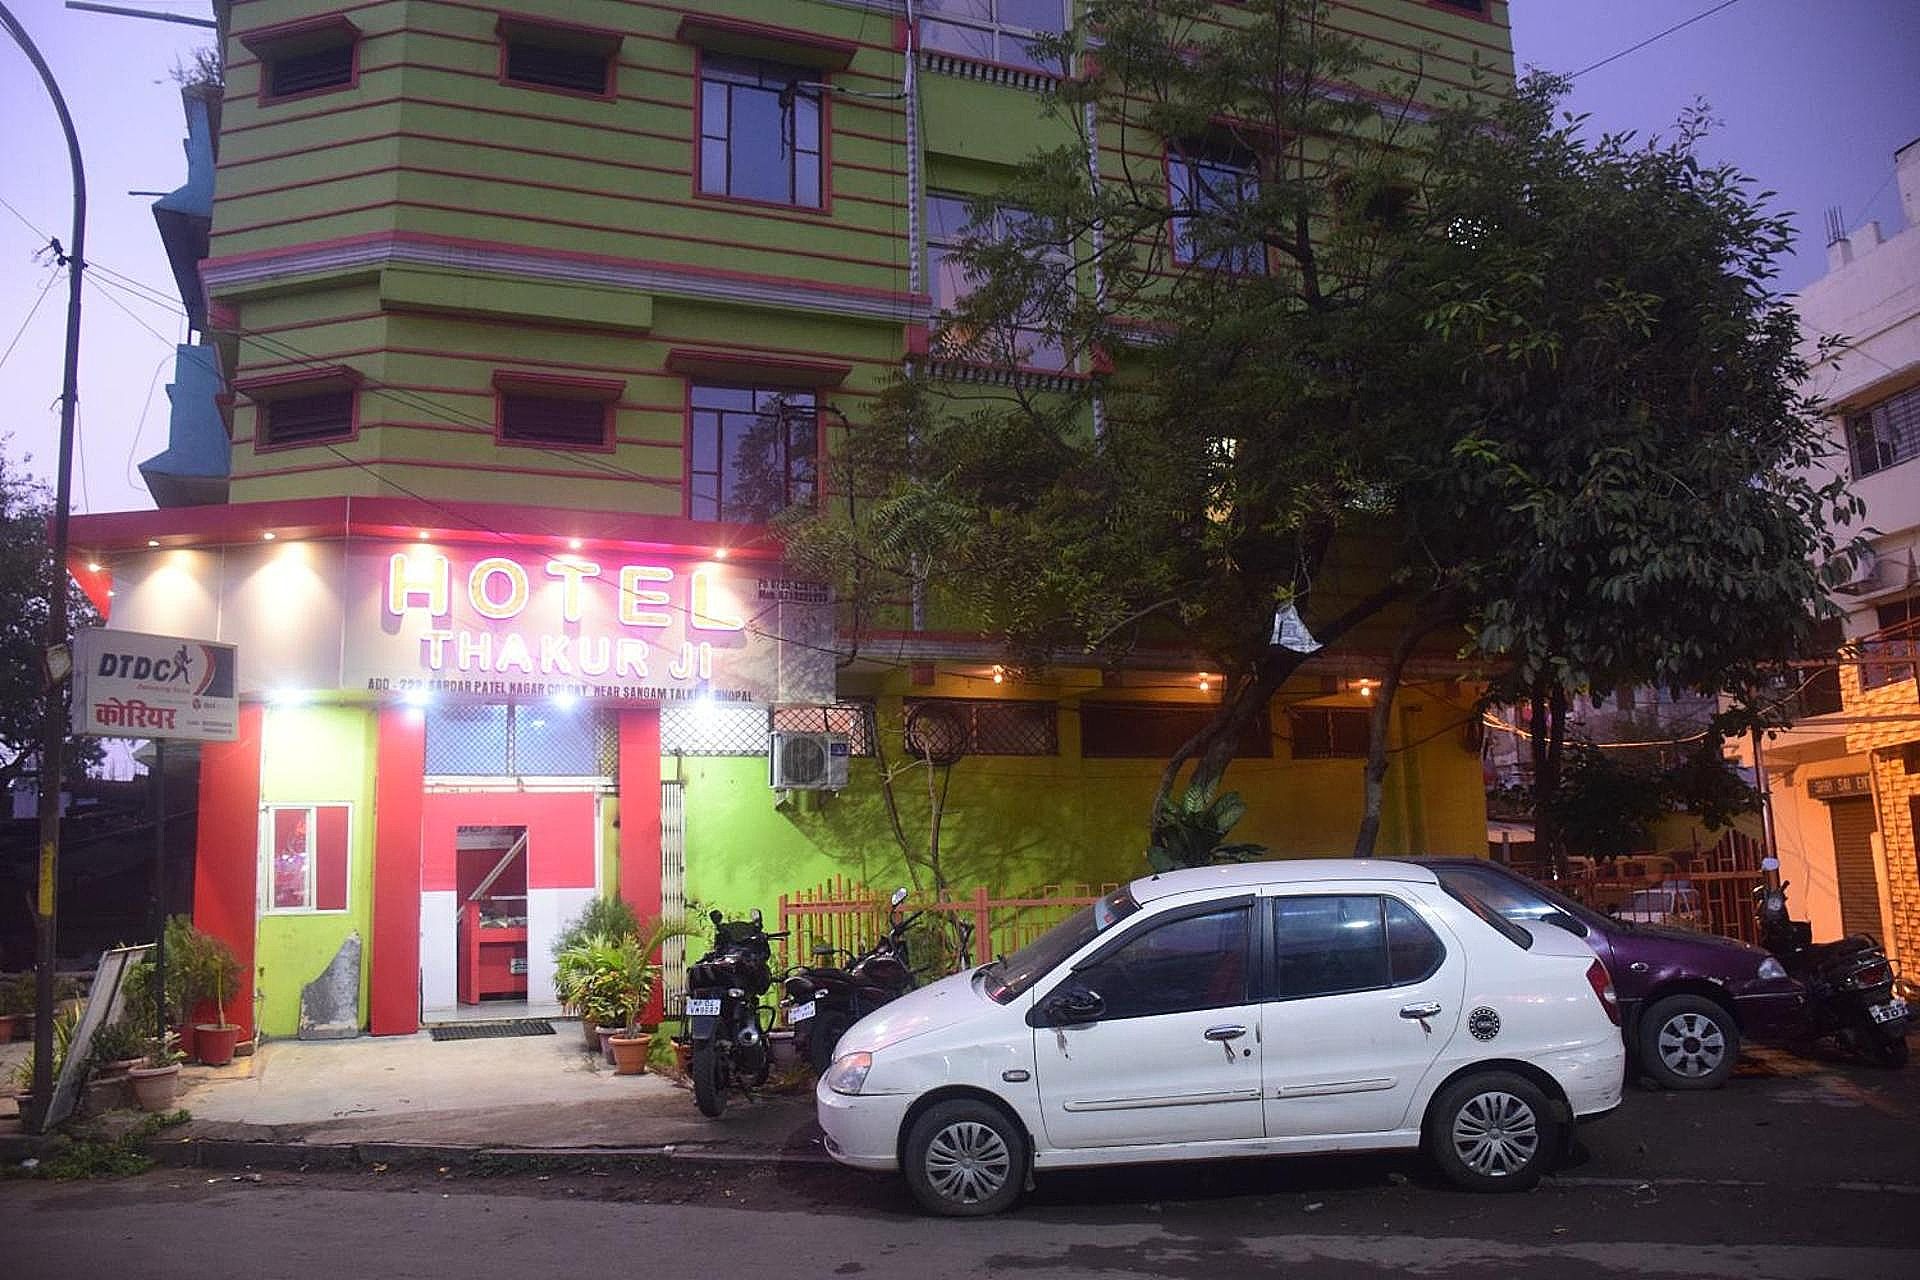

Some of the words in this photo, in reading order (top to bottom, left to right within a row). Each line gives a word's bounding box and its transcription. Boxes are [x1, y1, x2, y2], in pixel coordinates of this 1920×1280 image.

[388, 552, 745, 631] HOTEL
[98, 652, 171, 681] DTDC
[418, 628, 649, 678] THAKUR
[669, 641, 713, 680] JI
[474, 681, 505, 695] PATEL
[509, 682, 544, 697] NAGAR
[594, 685, 620, 697] NEAR
[623, 686, 666, 699] SANGAM
[670, 688, 710, 700] TALKI
[94, 697, 177, 729] कोरियर
